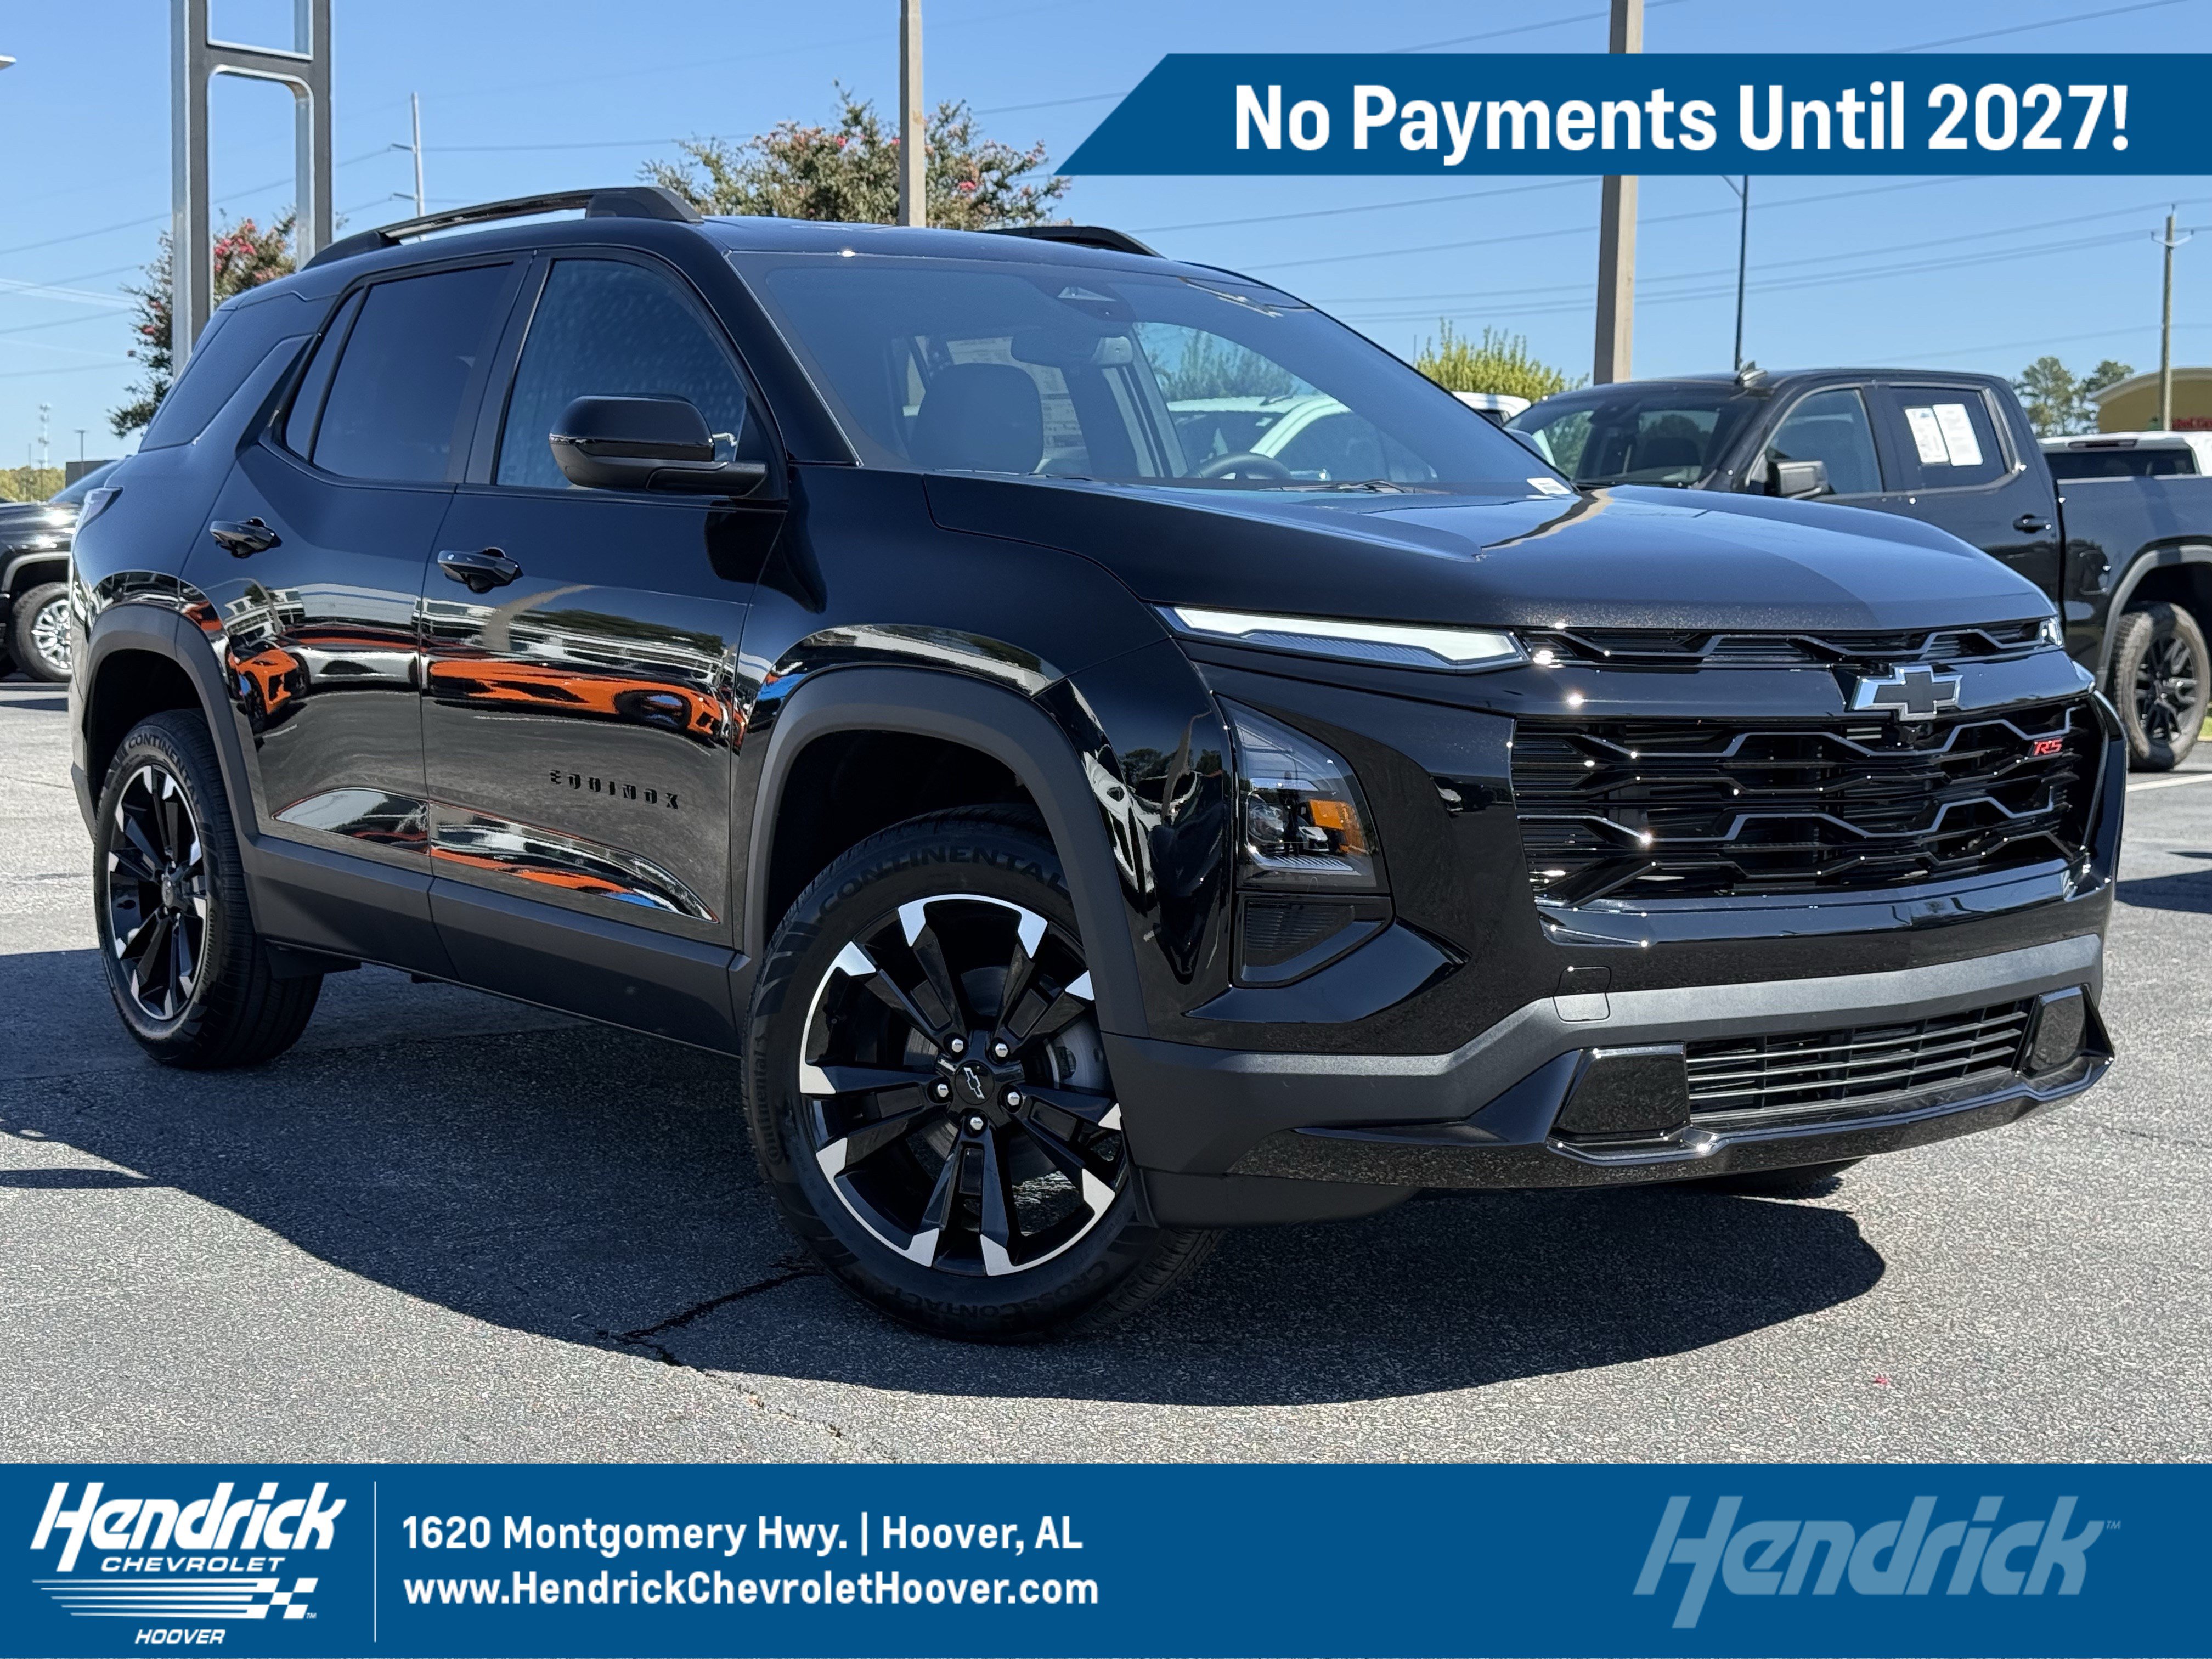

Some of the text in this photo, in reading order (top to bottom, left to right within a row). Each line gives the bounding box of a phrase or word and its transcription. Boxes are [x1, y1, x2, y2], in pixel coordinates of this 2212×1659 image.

[2034, 738, 2063, 755] RS
[549, 770, 679, 809] EQUINOX
[819, 845, 1070, 917] CONTINENTAL
